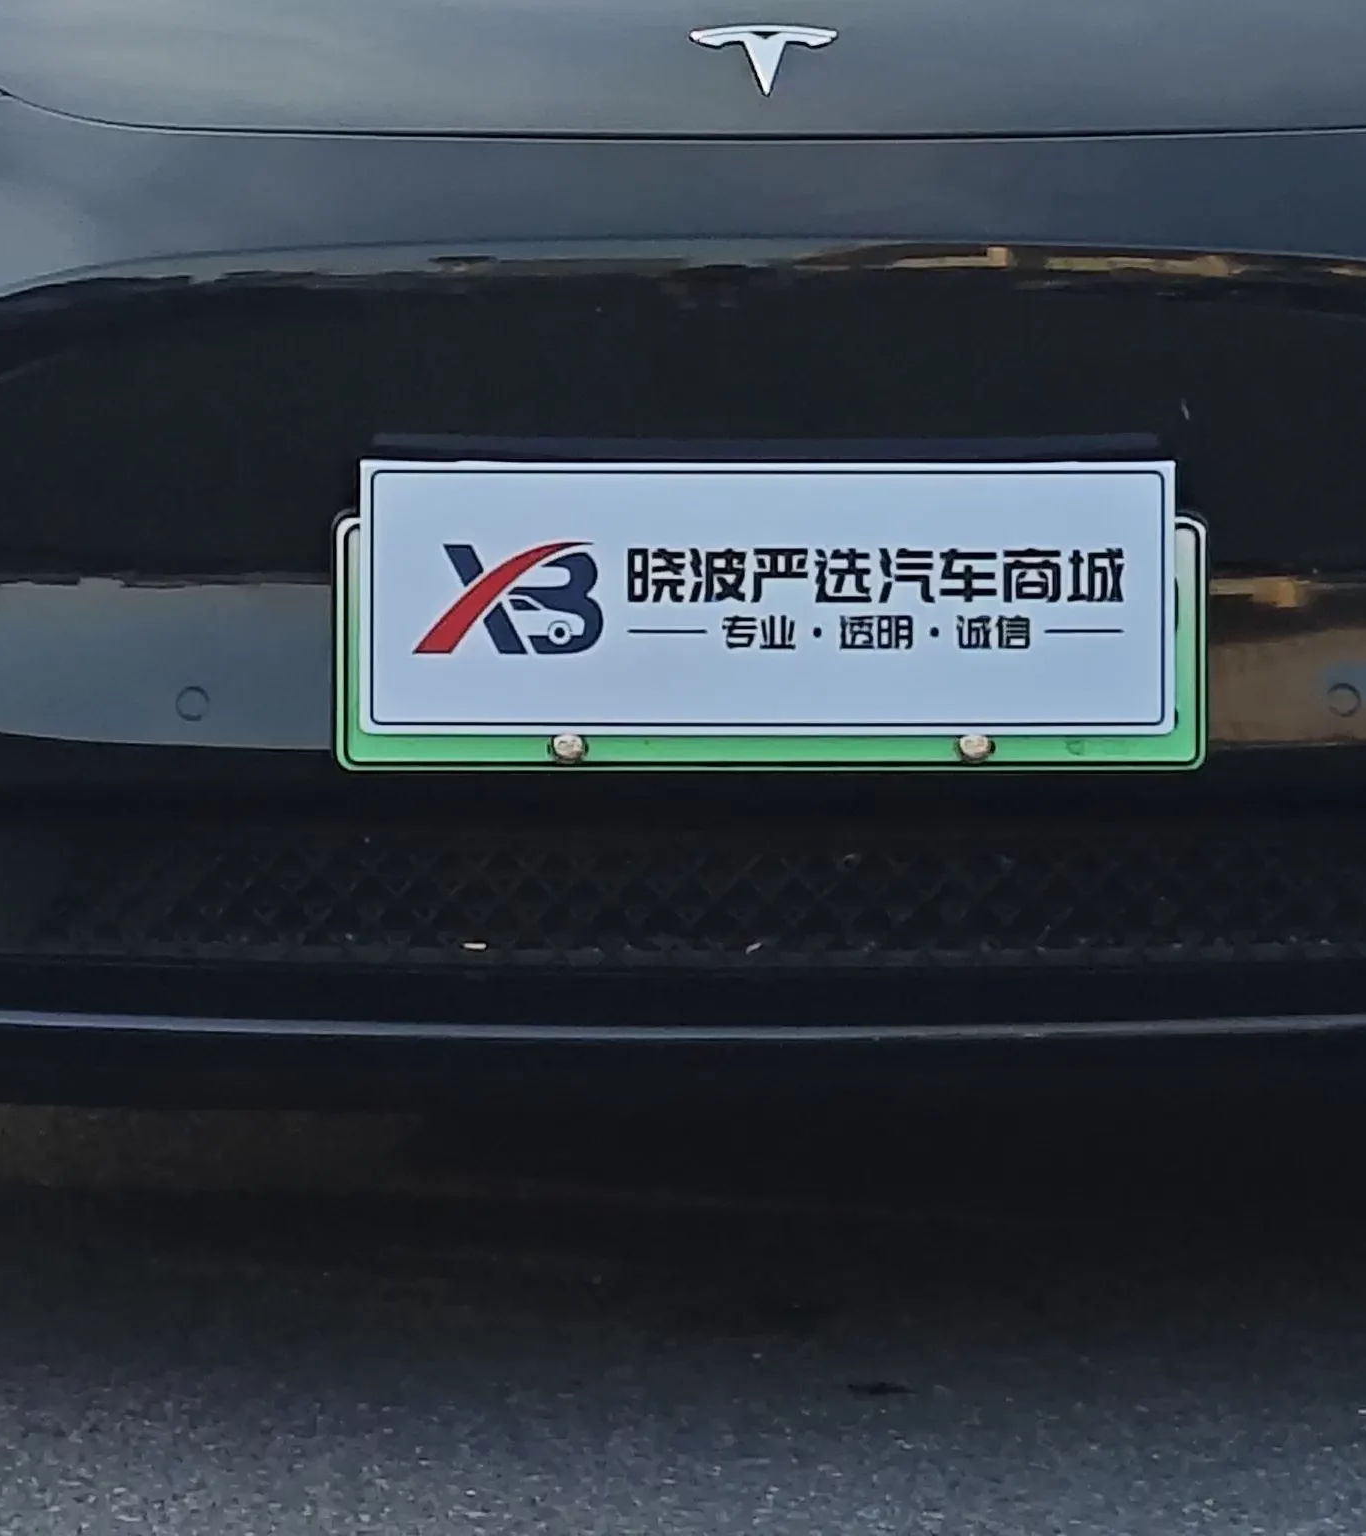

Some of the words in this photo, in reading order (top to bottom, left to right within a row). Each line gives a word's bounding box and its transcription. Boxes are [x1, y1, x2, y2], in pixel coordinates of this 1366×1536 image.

[626, 547, 1124, 604] 晓波严选汽车商城
